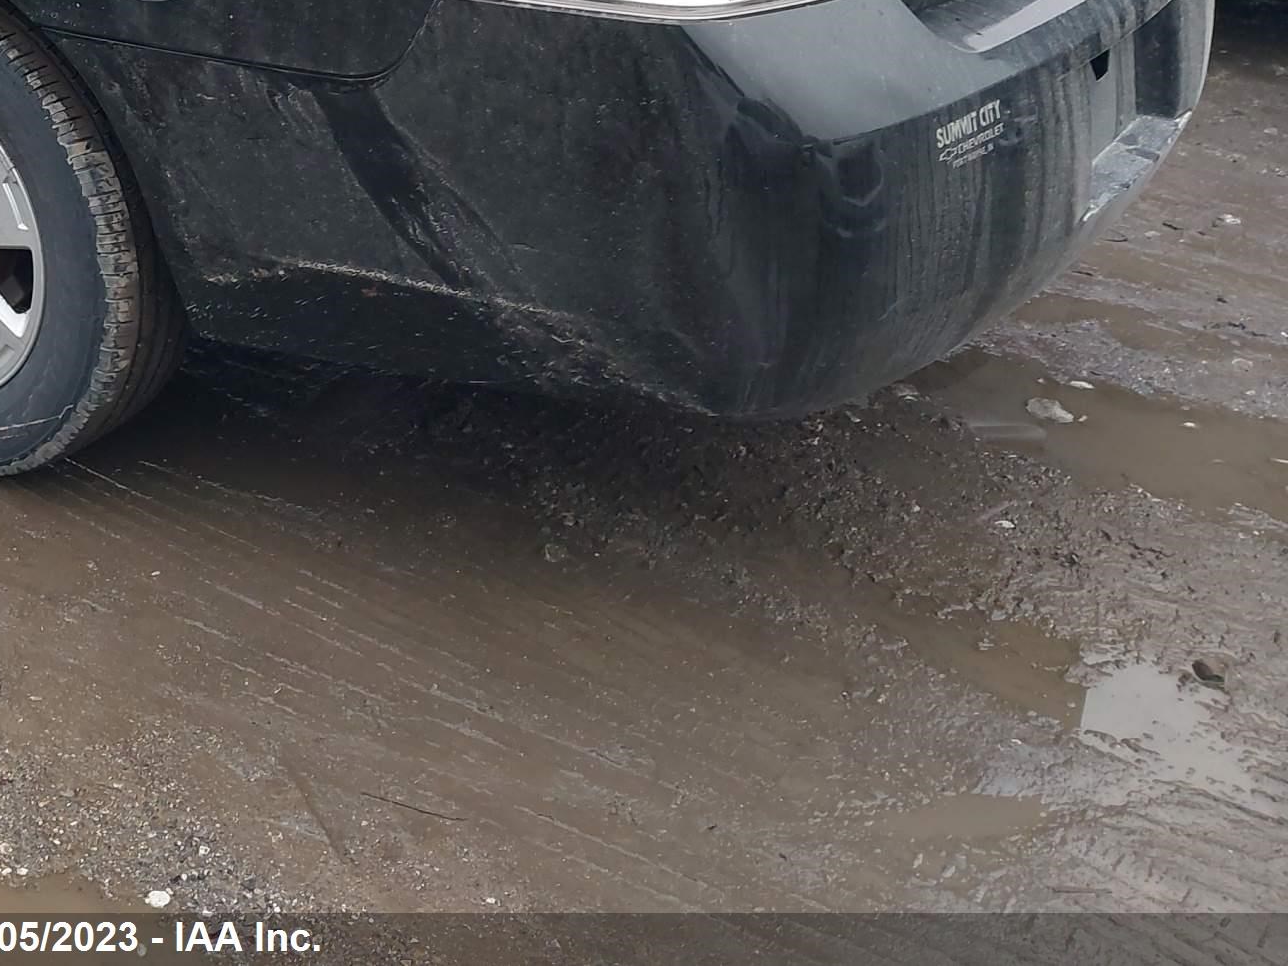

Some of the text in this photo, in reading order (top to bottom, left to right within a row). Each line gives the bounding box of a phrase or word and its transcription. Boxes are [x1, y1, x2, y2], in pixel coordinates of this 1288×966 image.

[936, 100, 1001, 147] SUMMIT CITY
[958, 123, 1003, 153] CHEVROLET
